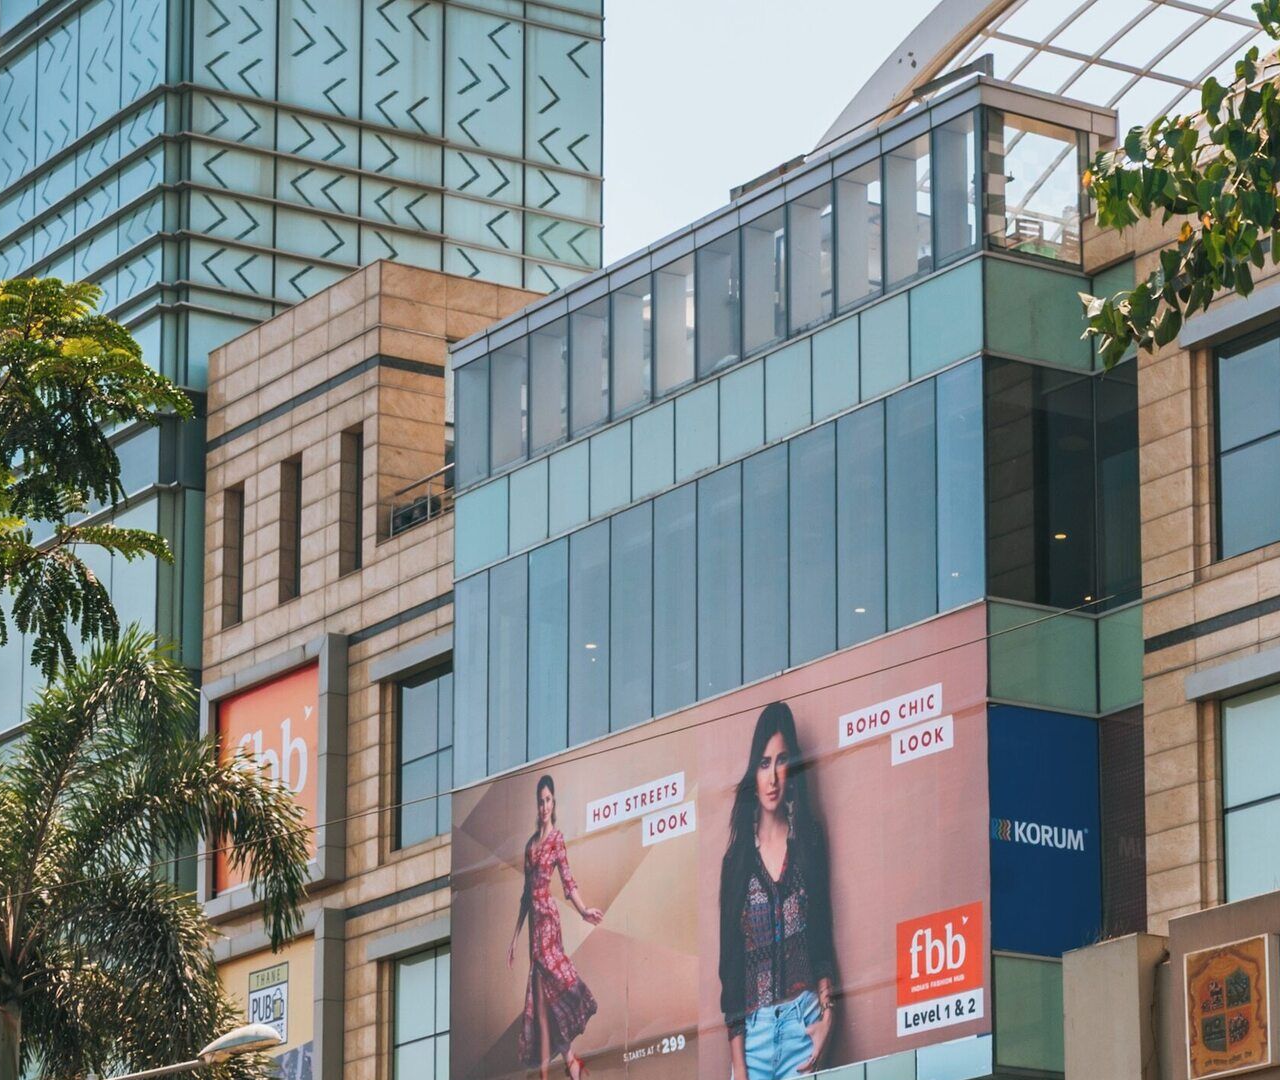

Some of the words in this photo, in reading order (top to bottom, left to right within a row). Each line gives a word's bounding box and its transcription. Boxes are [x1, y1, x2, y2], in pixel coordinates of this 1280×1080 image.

[847, 709, 890, 736] BOHO
[898, 694, 934, 719] CHIC
[900, 727, 943, 754] LOOK
[593, 802, 619, 822] HOT
[625, 782, 678, 811] STREETS
[650, 811, 688, 836] LOOK
[1014, 821, 1084, 851] KORUM
[909, 922, 966, 979] fbb
[256, 969, 280, 987] THANE
[252, 995, 271, 1023] PUB
[904, 1004, 941, 1028] Level
[945, 1004, 950, 1019] 1
[955, 999, 963, 1016] &
[968, 998, 975, 1014] 2
[647, 1045, 655, 1055] AT
